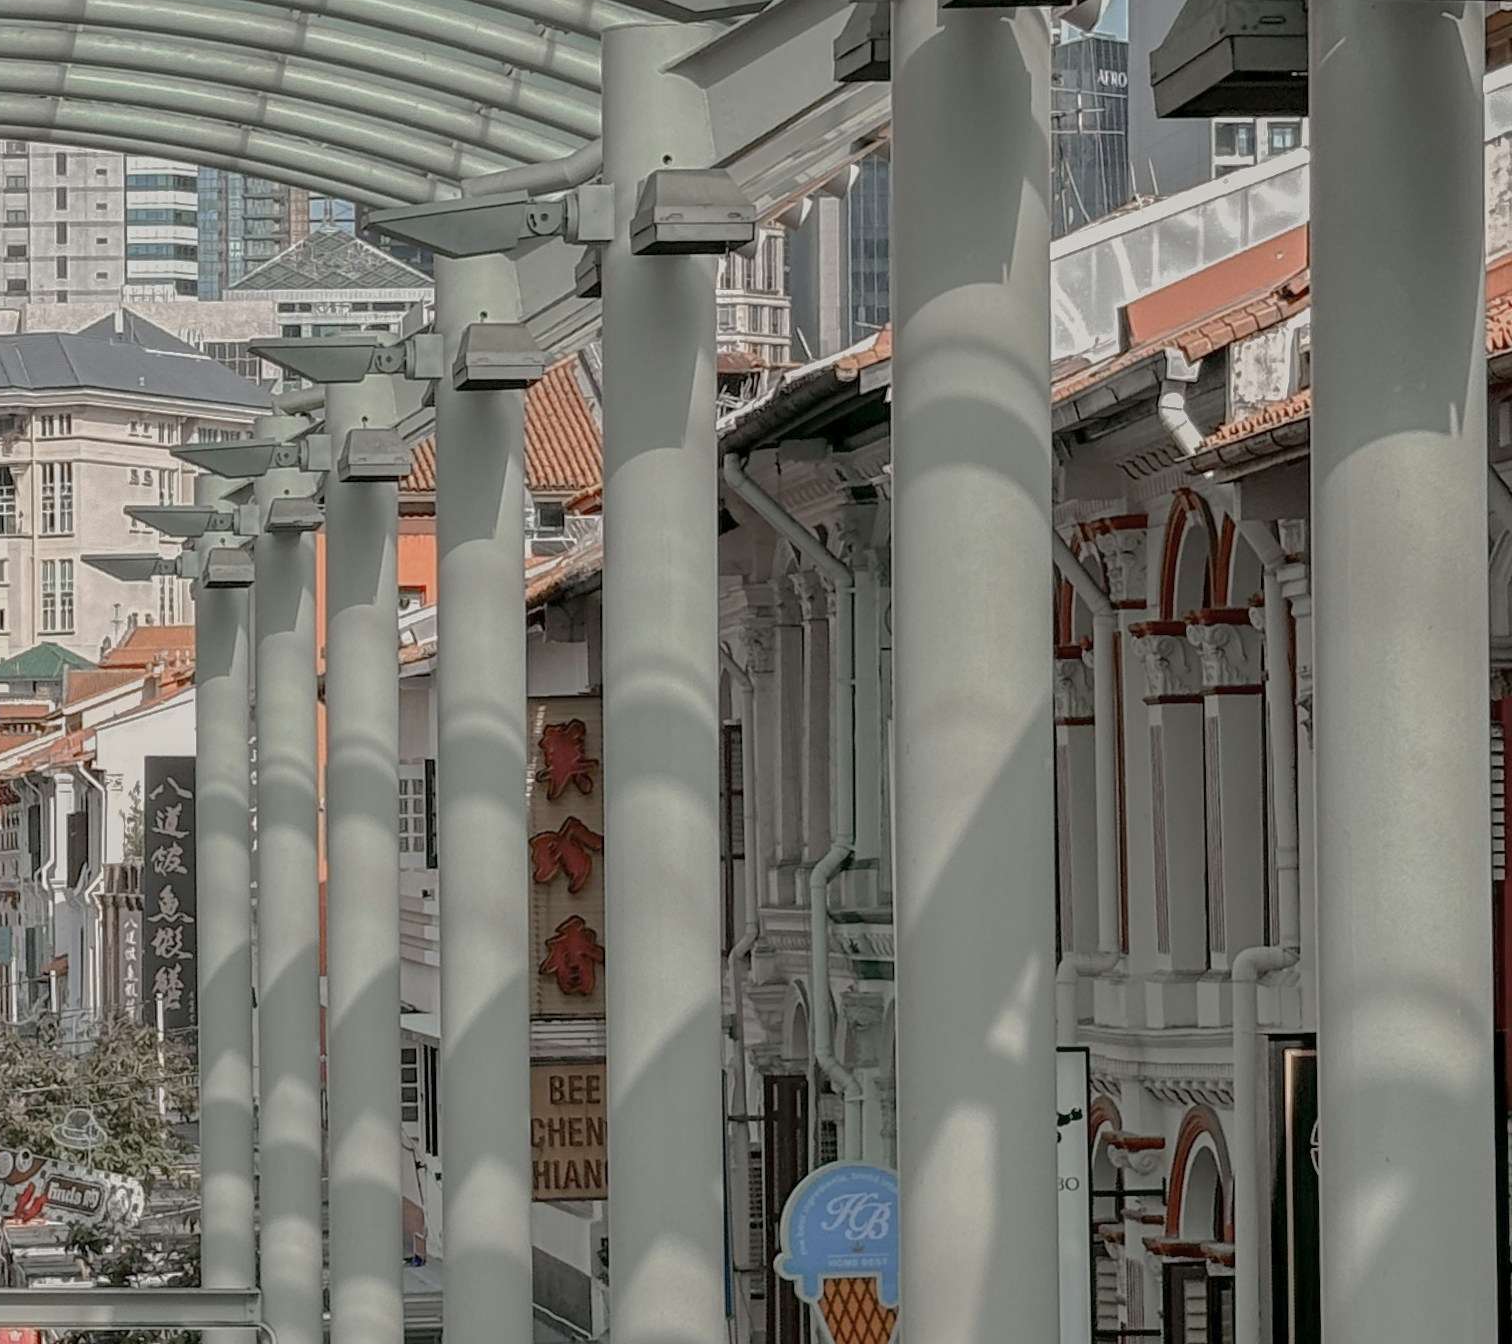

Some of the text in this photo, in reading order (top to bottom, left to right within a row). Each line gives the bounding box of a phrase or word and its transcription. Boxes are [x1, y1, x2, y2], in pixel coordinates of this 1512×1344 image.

[549, 1074, 601, 1105] BEE
[530, 1116, 608, 1148] CHEN
[532, 1159, 608, 1190] HIAN
